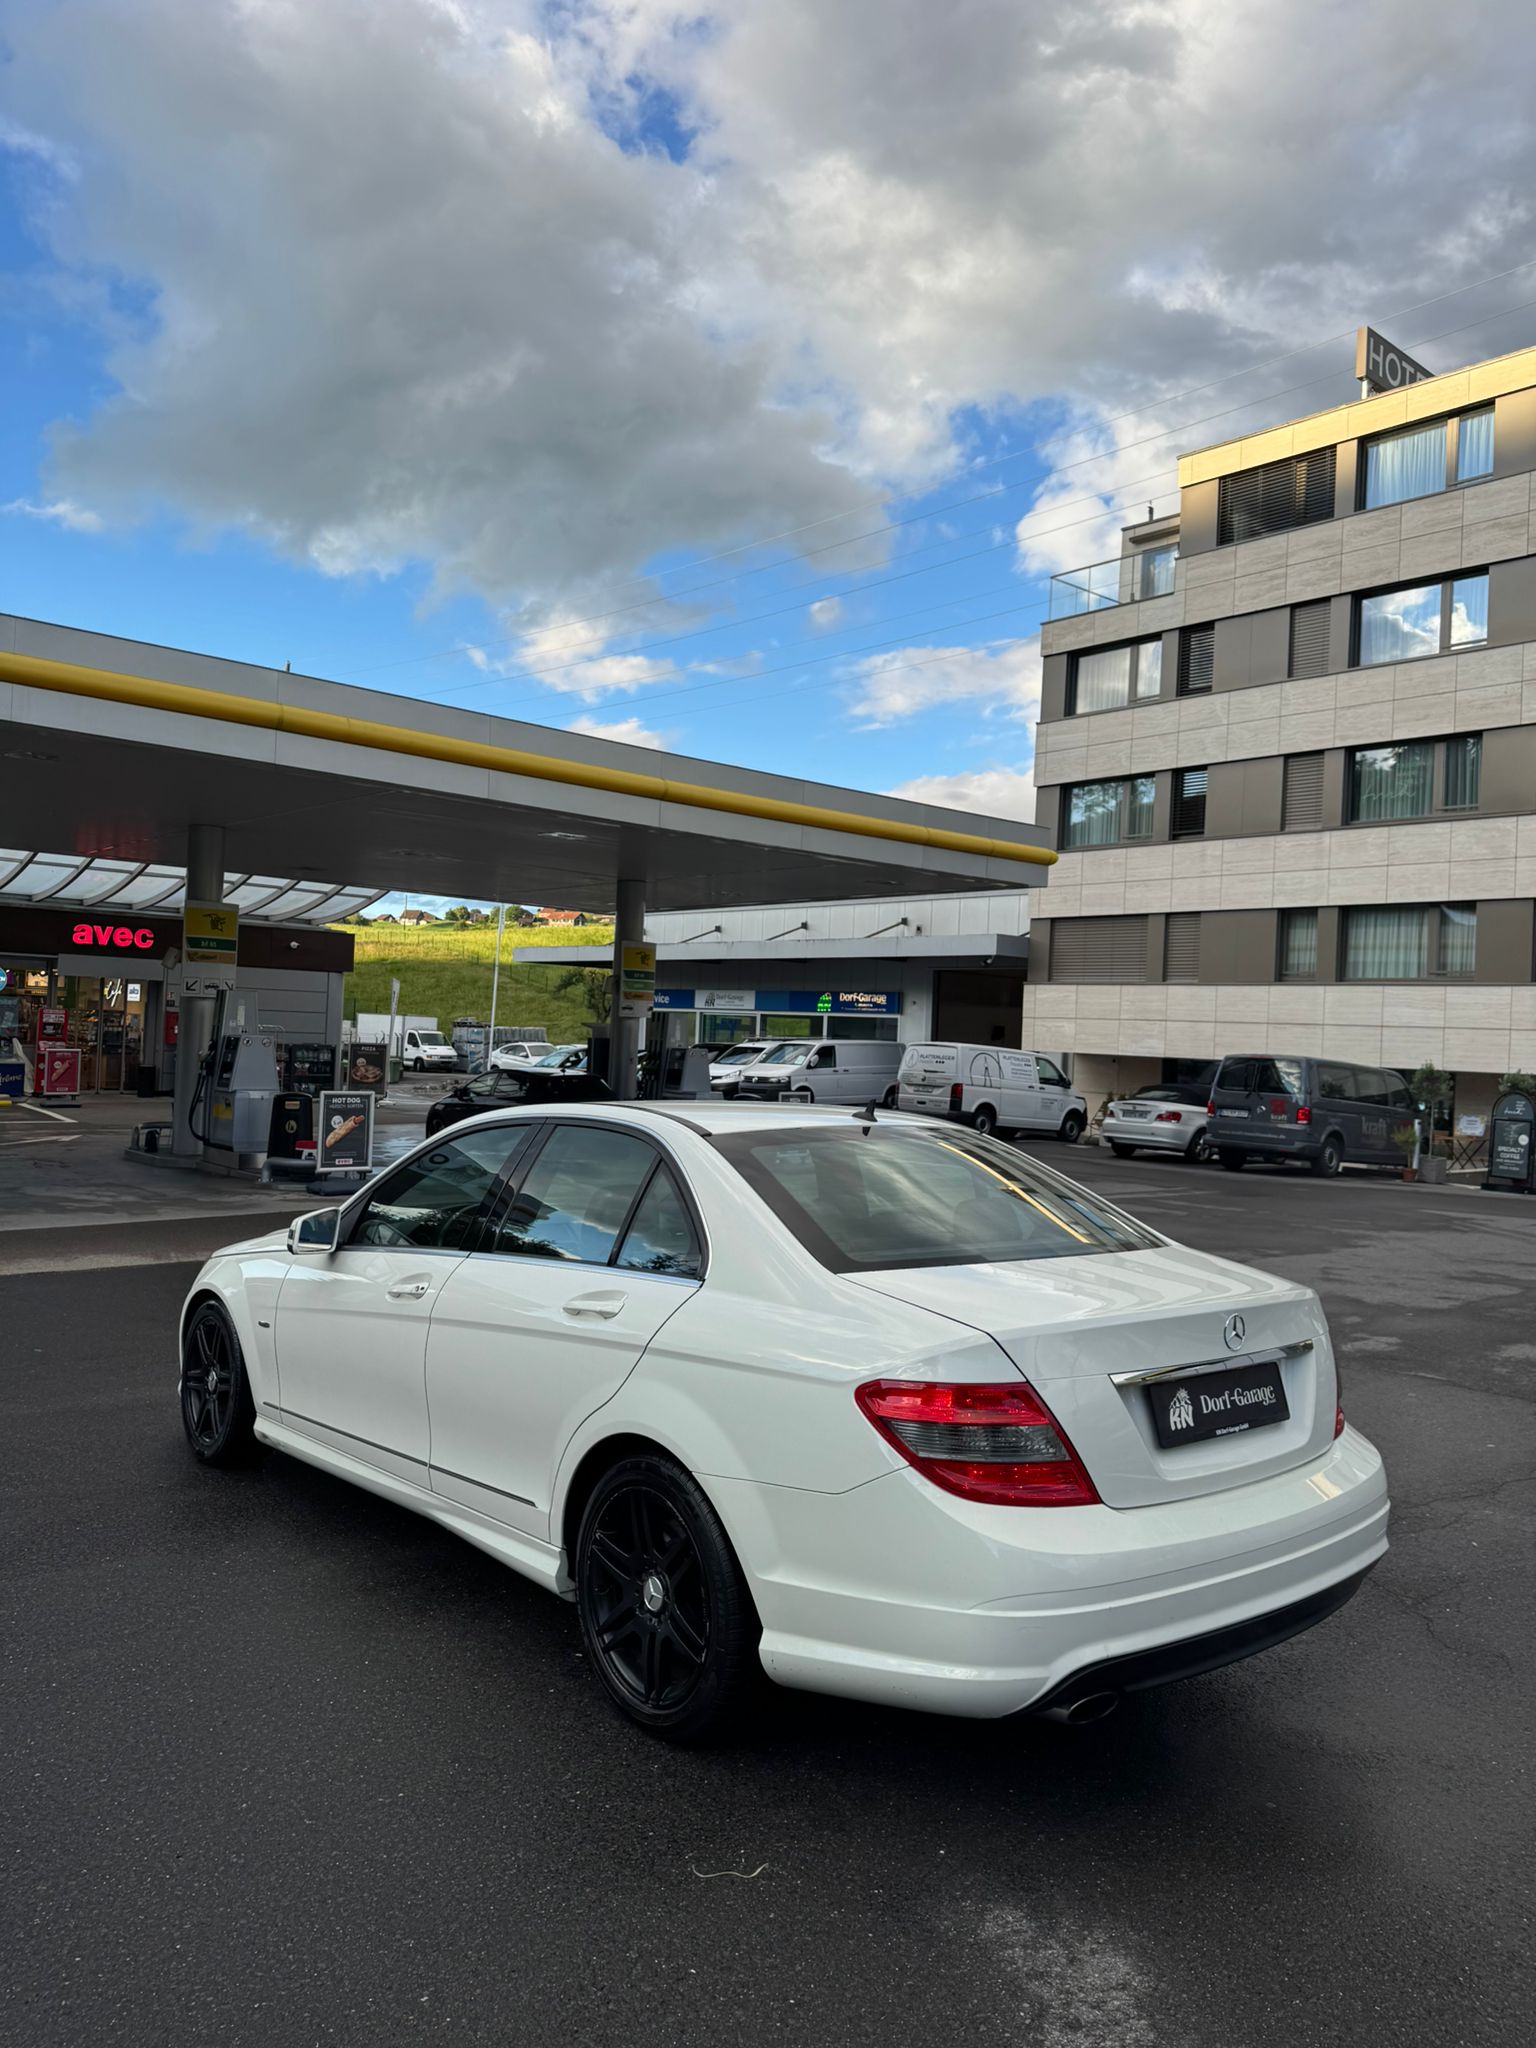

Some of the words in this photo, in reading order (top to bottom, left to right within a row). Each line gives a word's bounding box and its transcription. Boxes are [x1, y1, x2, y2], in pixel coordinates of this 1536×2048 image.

[72, 923, 154, 948] avec
[840, 993, 887, 1004] Dorf-Garage
[1361, 1116, 1387, 1137] kraft
[1200, 1385, 1276, 1414] Dorf-Garage
